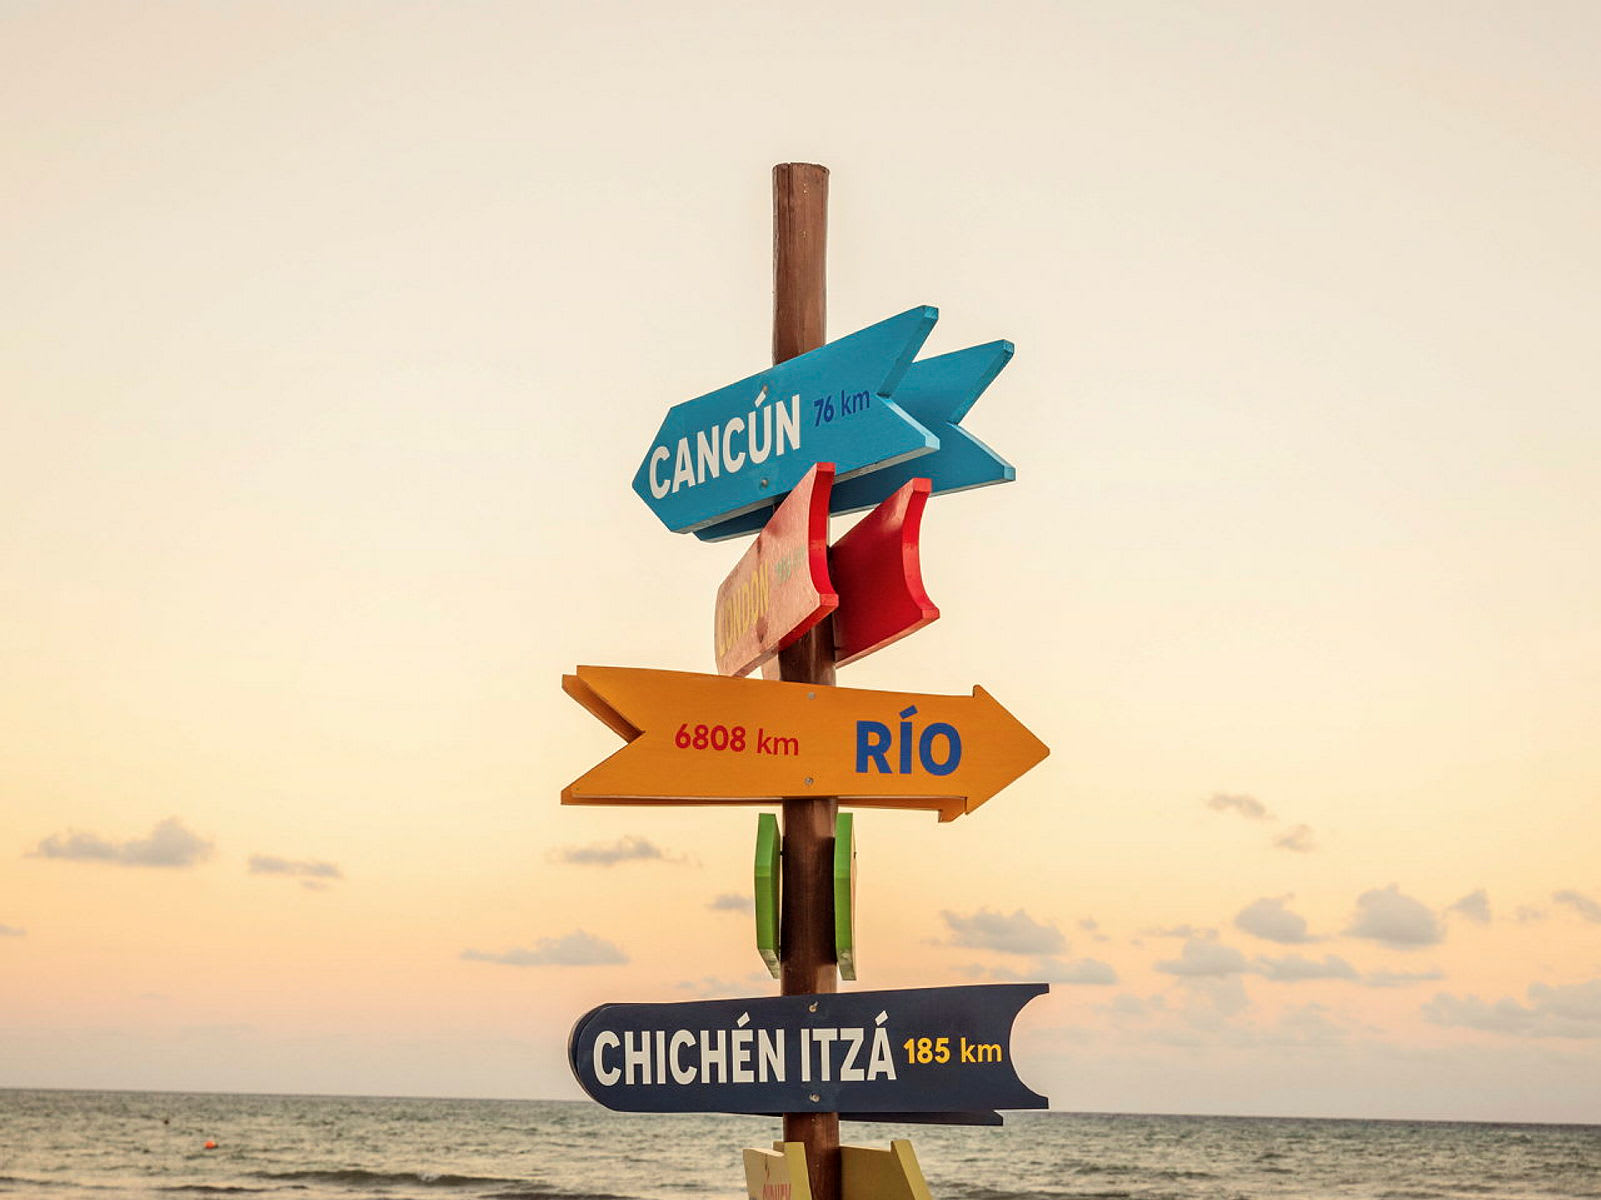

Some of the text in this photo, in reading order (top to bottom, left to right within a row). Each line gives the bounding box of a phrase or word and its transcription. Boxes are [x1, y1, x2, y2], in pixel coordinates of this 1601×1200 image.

[650, 389, 870, 499] CANCÚN 76 km
[719, 559, 769, 657] LONDON
[675, 704, 962, 776] 6808 km RÍO
[593, 1010, 1002, 1086] CHICHÉN ITZÁ 185 km
